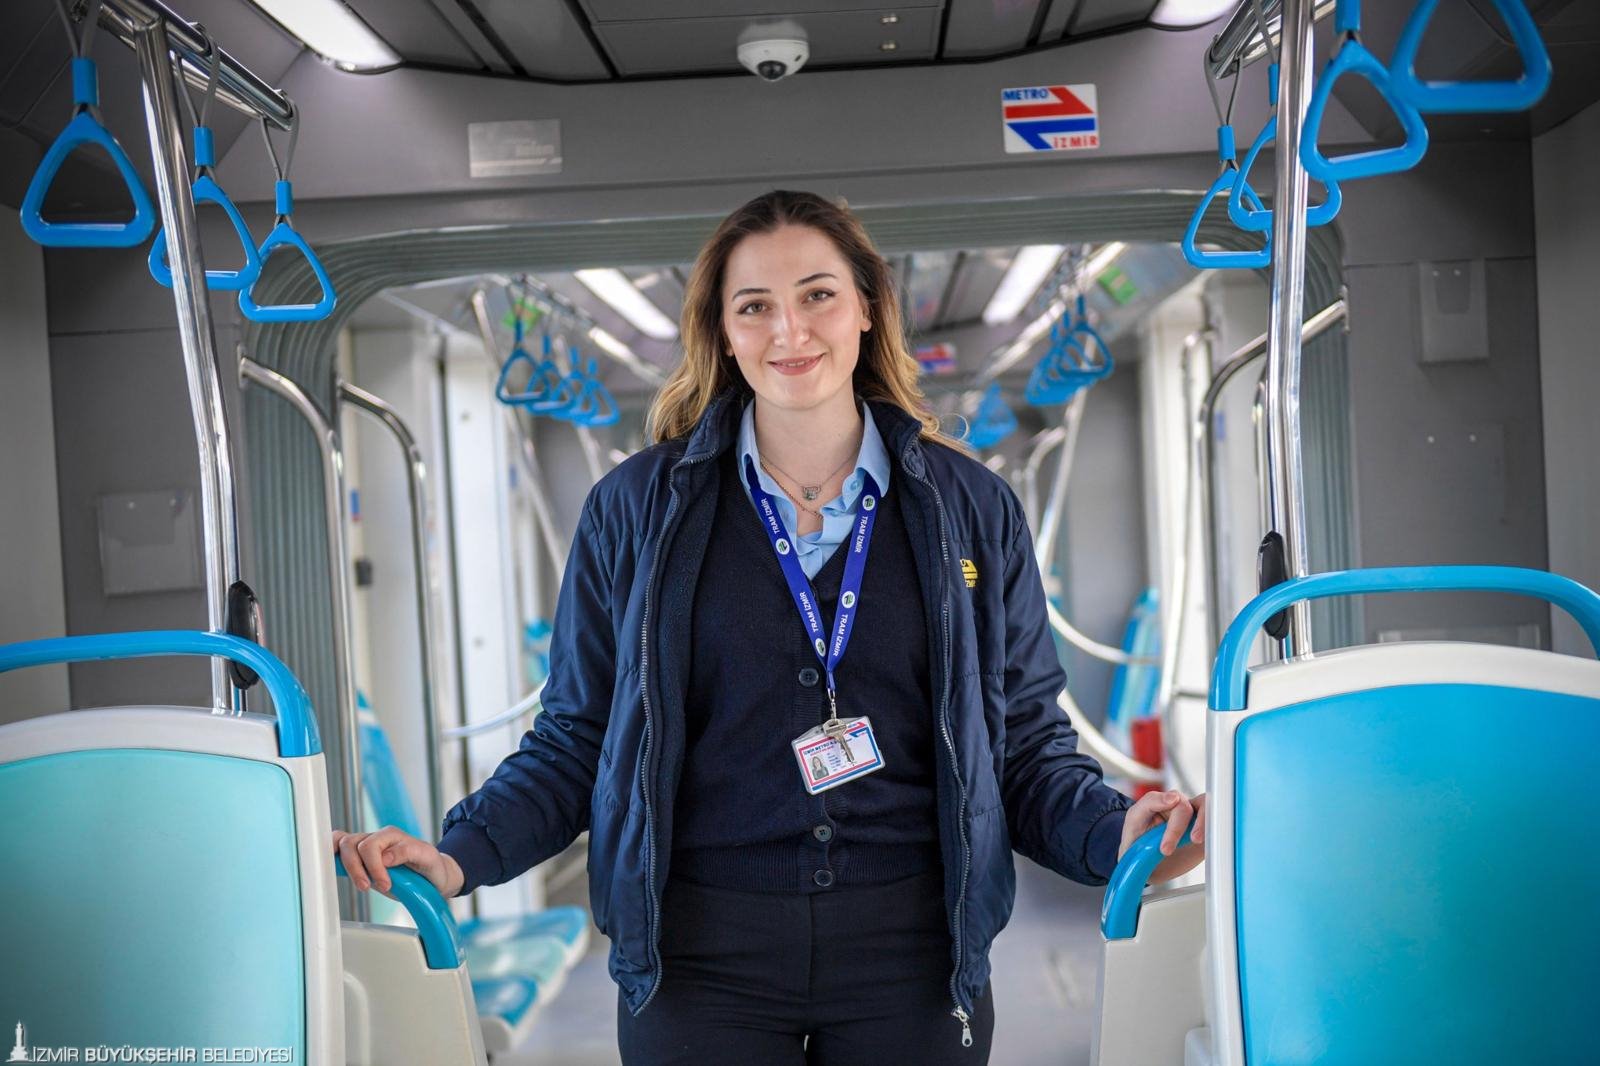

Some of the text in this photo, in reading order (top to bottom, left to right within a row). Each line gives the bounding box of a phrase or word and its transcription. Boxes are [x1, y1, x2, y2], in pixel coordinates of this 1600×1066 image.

[1003, 88, 1048, 101] METRO
[1053, 135, 1097, 148] İZMİR
[768, 515, 780, 534] TRAM
[858, 516, 868, 535] TRAM
[807, 610, 819, 633] TRAM
[838, 614, 849, 635] TRAM
